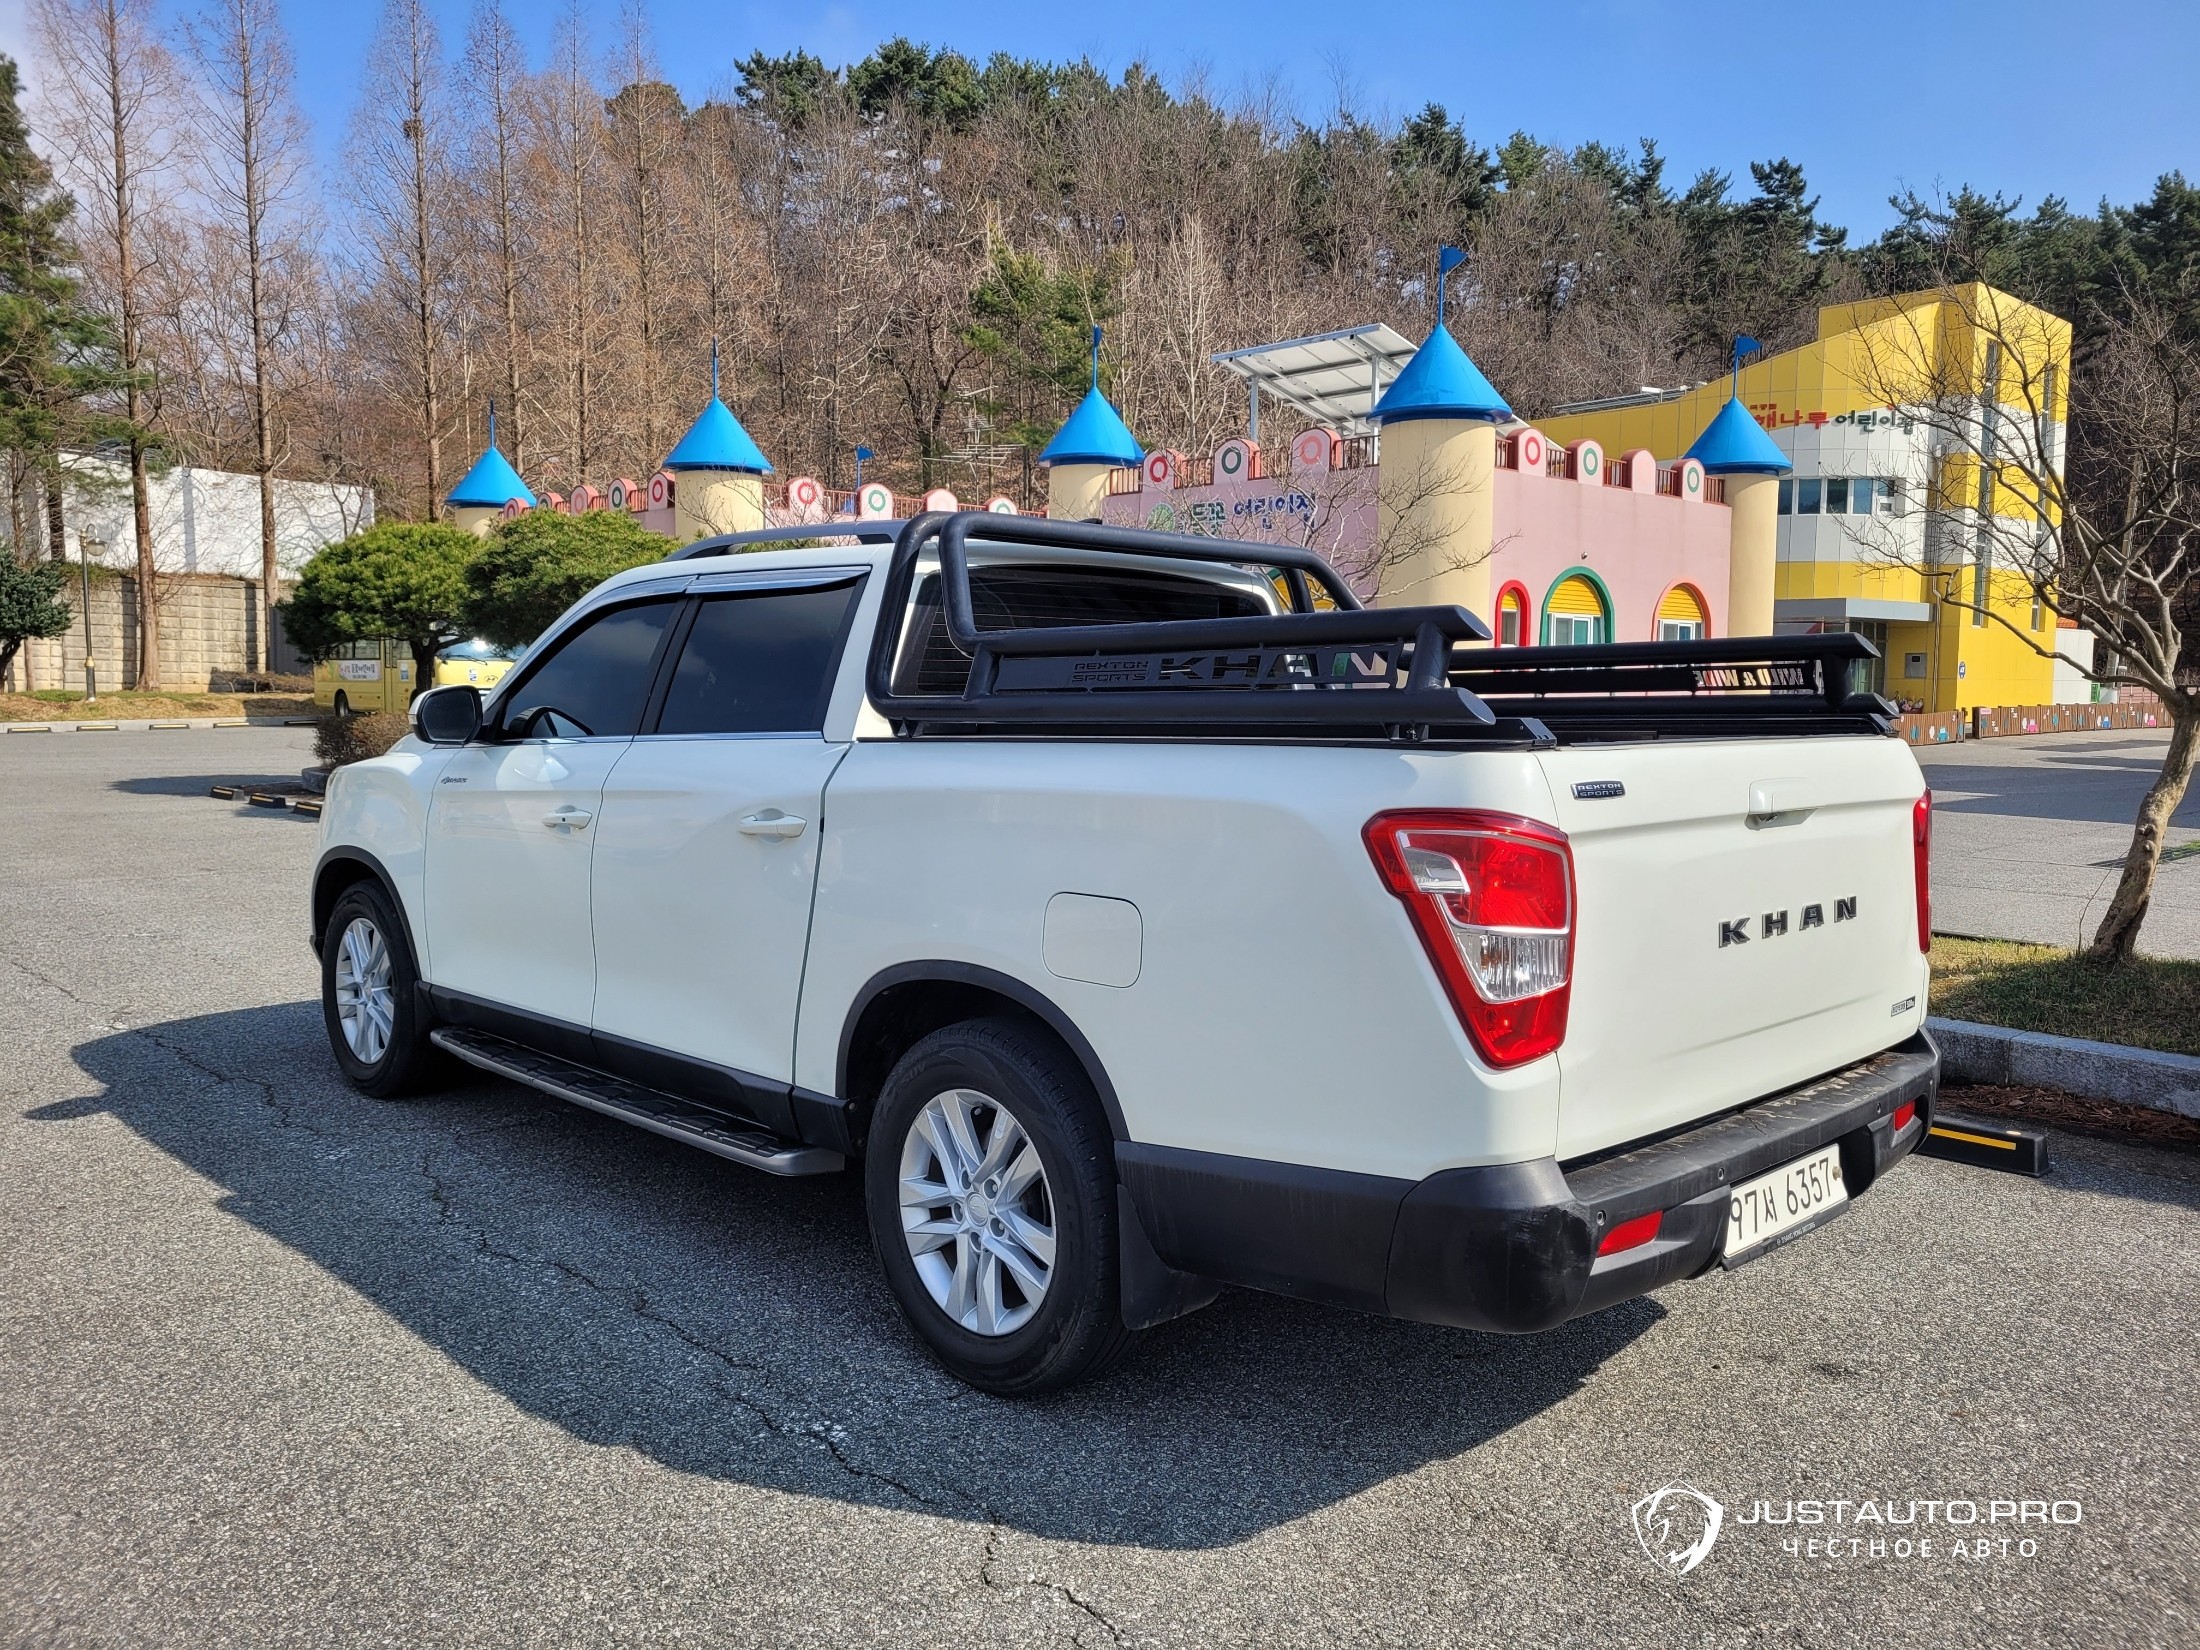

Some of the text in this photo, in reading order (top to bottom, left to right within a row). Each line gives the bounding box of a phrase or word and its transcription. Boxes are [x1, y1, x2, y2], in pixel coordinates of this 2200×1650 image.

[1074, 660, 1149, 671] REXTON
[1158, 651, 1388, 680] KHAN
[1072, 673, 1147, 683] SPORTS
[1580, 789, 1623, 797] SPORTS
[1718, 895, 1857, 948] KHAN
[1730, 1157, 1831, 1240] 97서 6357
